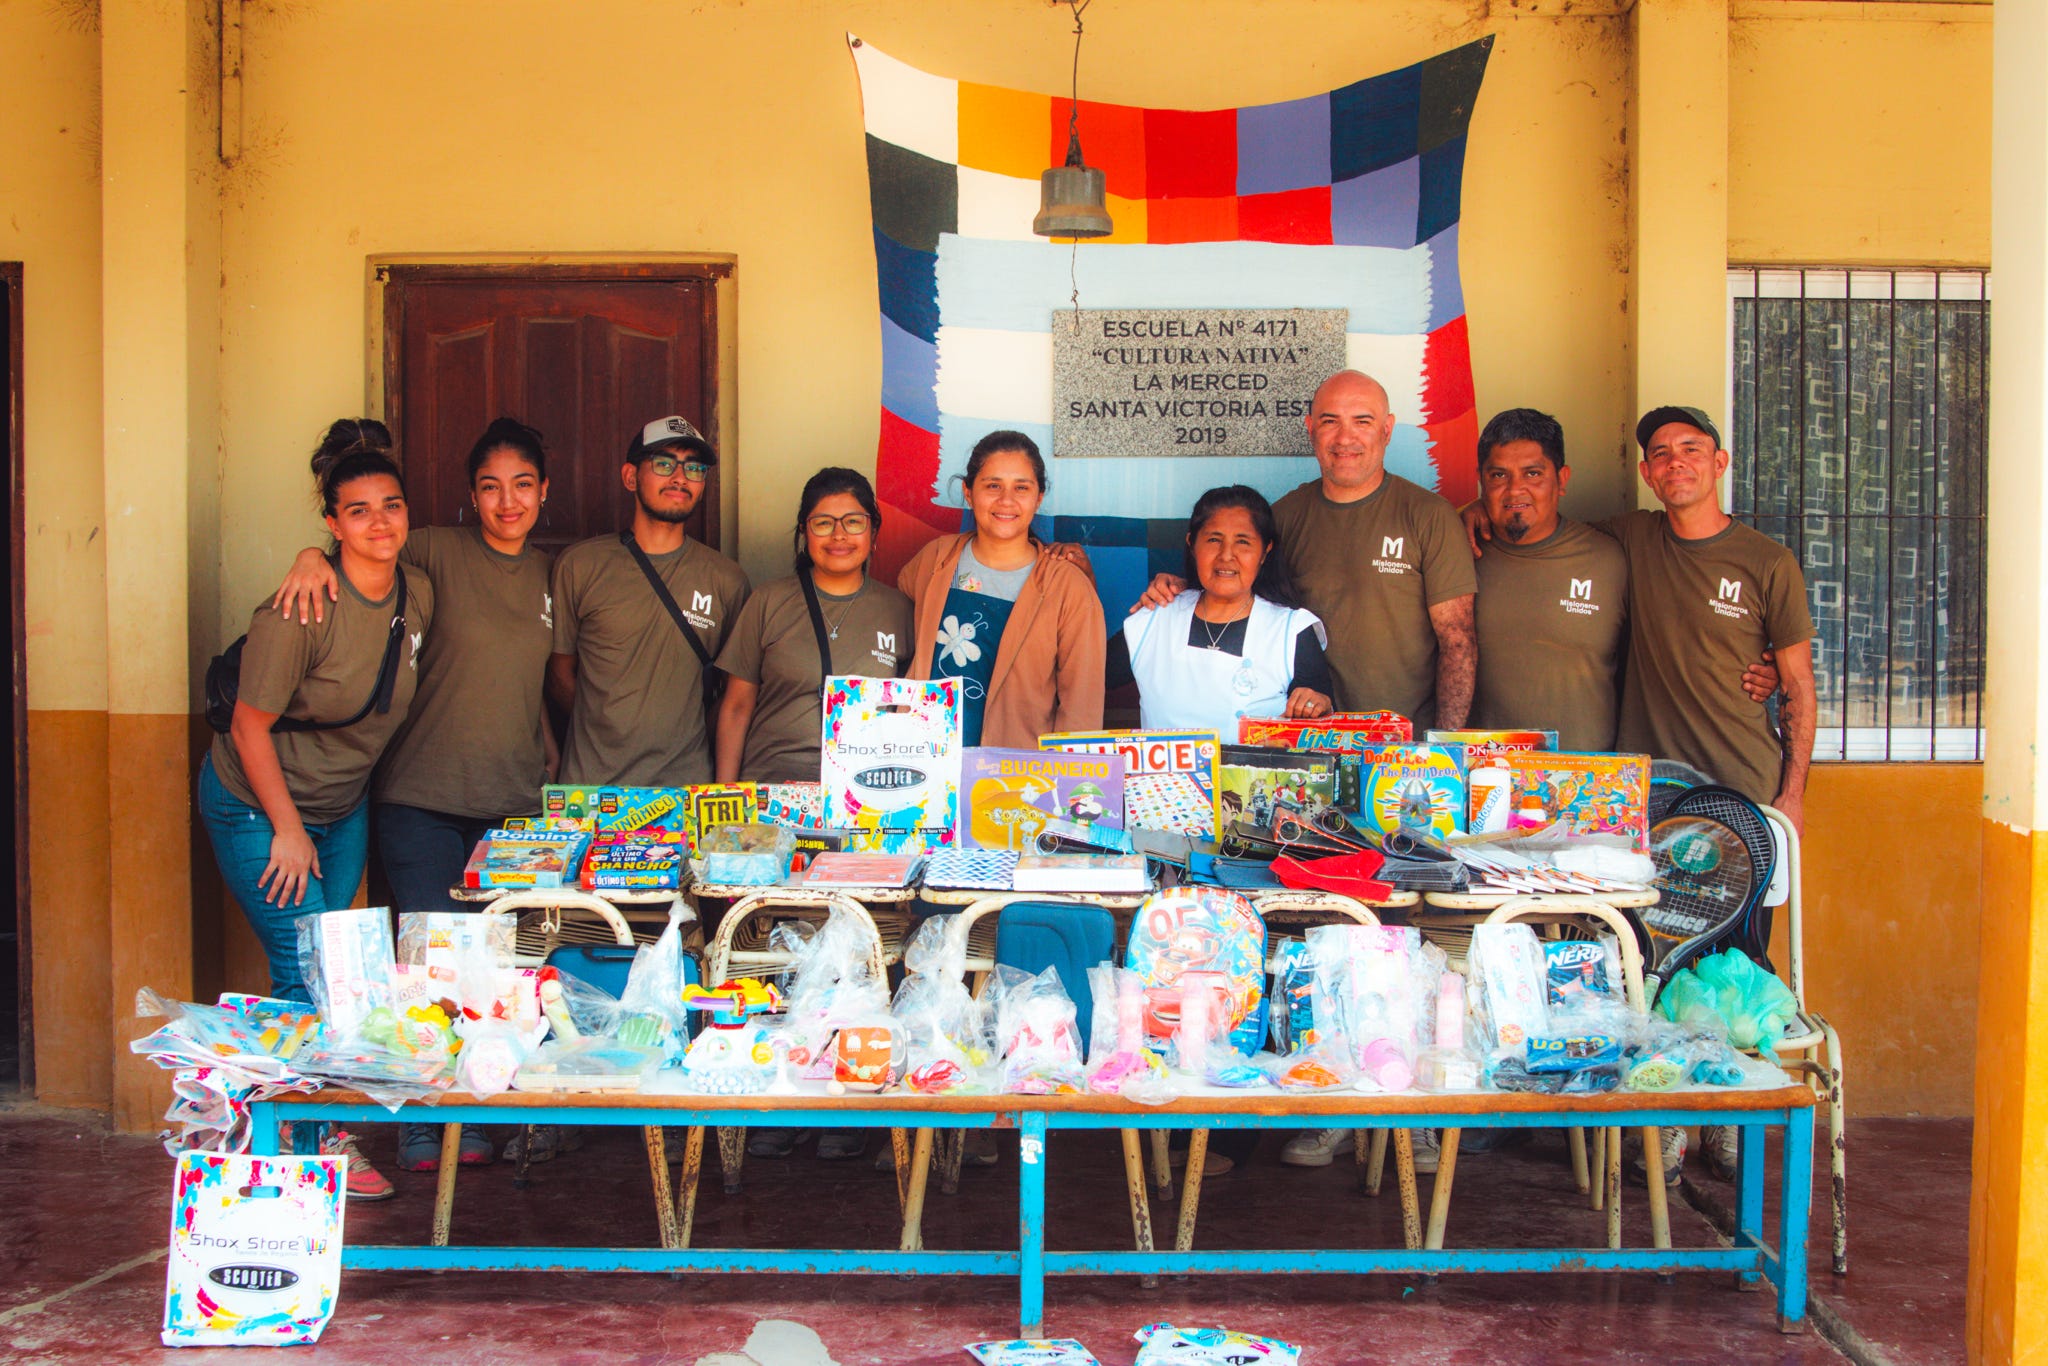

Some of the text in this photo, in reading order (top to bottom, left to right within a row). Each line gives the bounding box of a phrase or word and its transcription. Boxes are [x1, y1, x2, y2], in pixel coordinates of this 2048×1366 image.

[1103, 320, 1210, 338] ESCUELA
[1252, 320, 1298, 338] 4171
[1133, 374, 1269, 391] LA MERCED
[1070, 400, 1148, 418] SANTA
[1155, 400, 1267, 418] VICTORIA
[1175, 427, 1227, 444] 2019
[1371, 559, 1412, 570] Misioneros
[1378, 566, 1404, 574] Unidos
[1559, 599, 1599, 611] Misioneros
[1566, 605, 1592, 615] Unidos
[1708, 599, 1749, 615] Misioneros
[1714, 606, 1740, 619] Unidos
[837, 743, 925, 755] Shox Store
[1000, 758, 1109, 778] BUCANERO
[1378, 765, 1458, 779] The Ball Drop
[866, 770, 912, 786] SCOOTER
[703, 800, 739, 822] TRI
[588, 860, 673, 871] CHANCHO
[1547, 944, 1605, 969] NERF
[190, 1233, 299, 1251] Shox Store
[223, 1268, 282, 1288] SCOOTER
